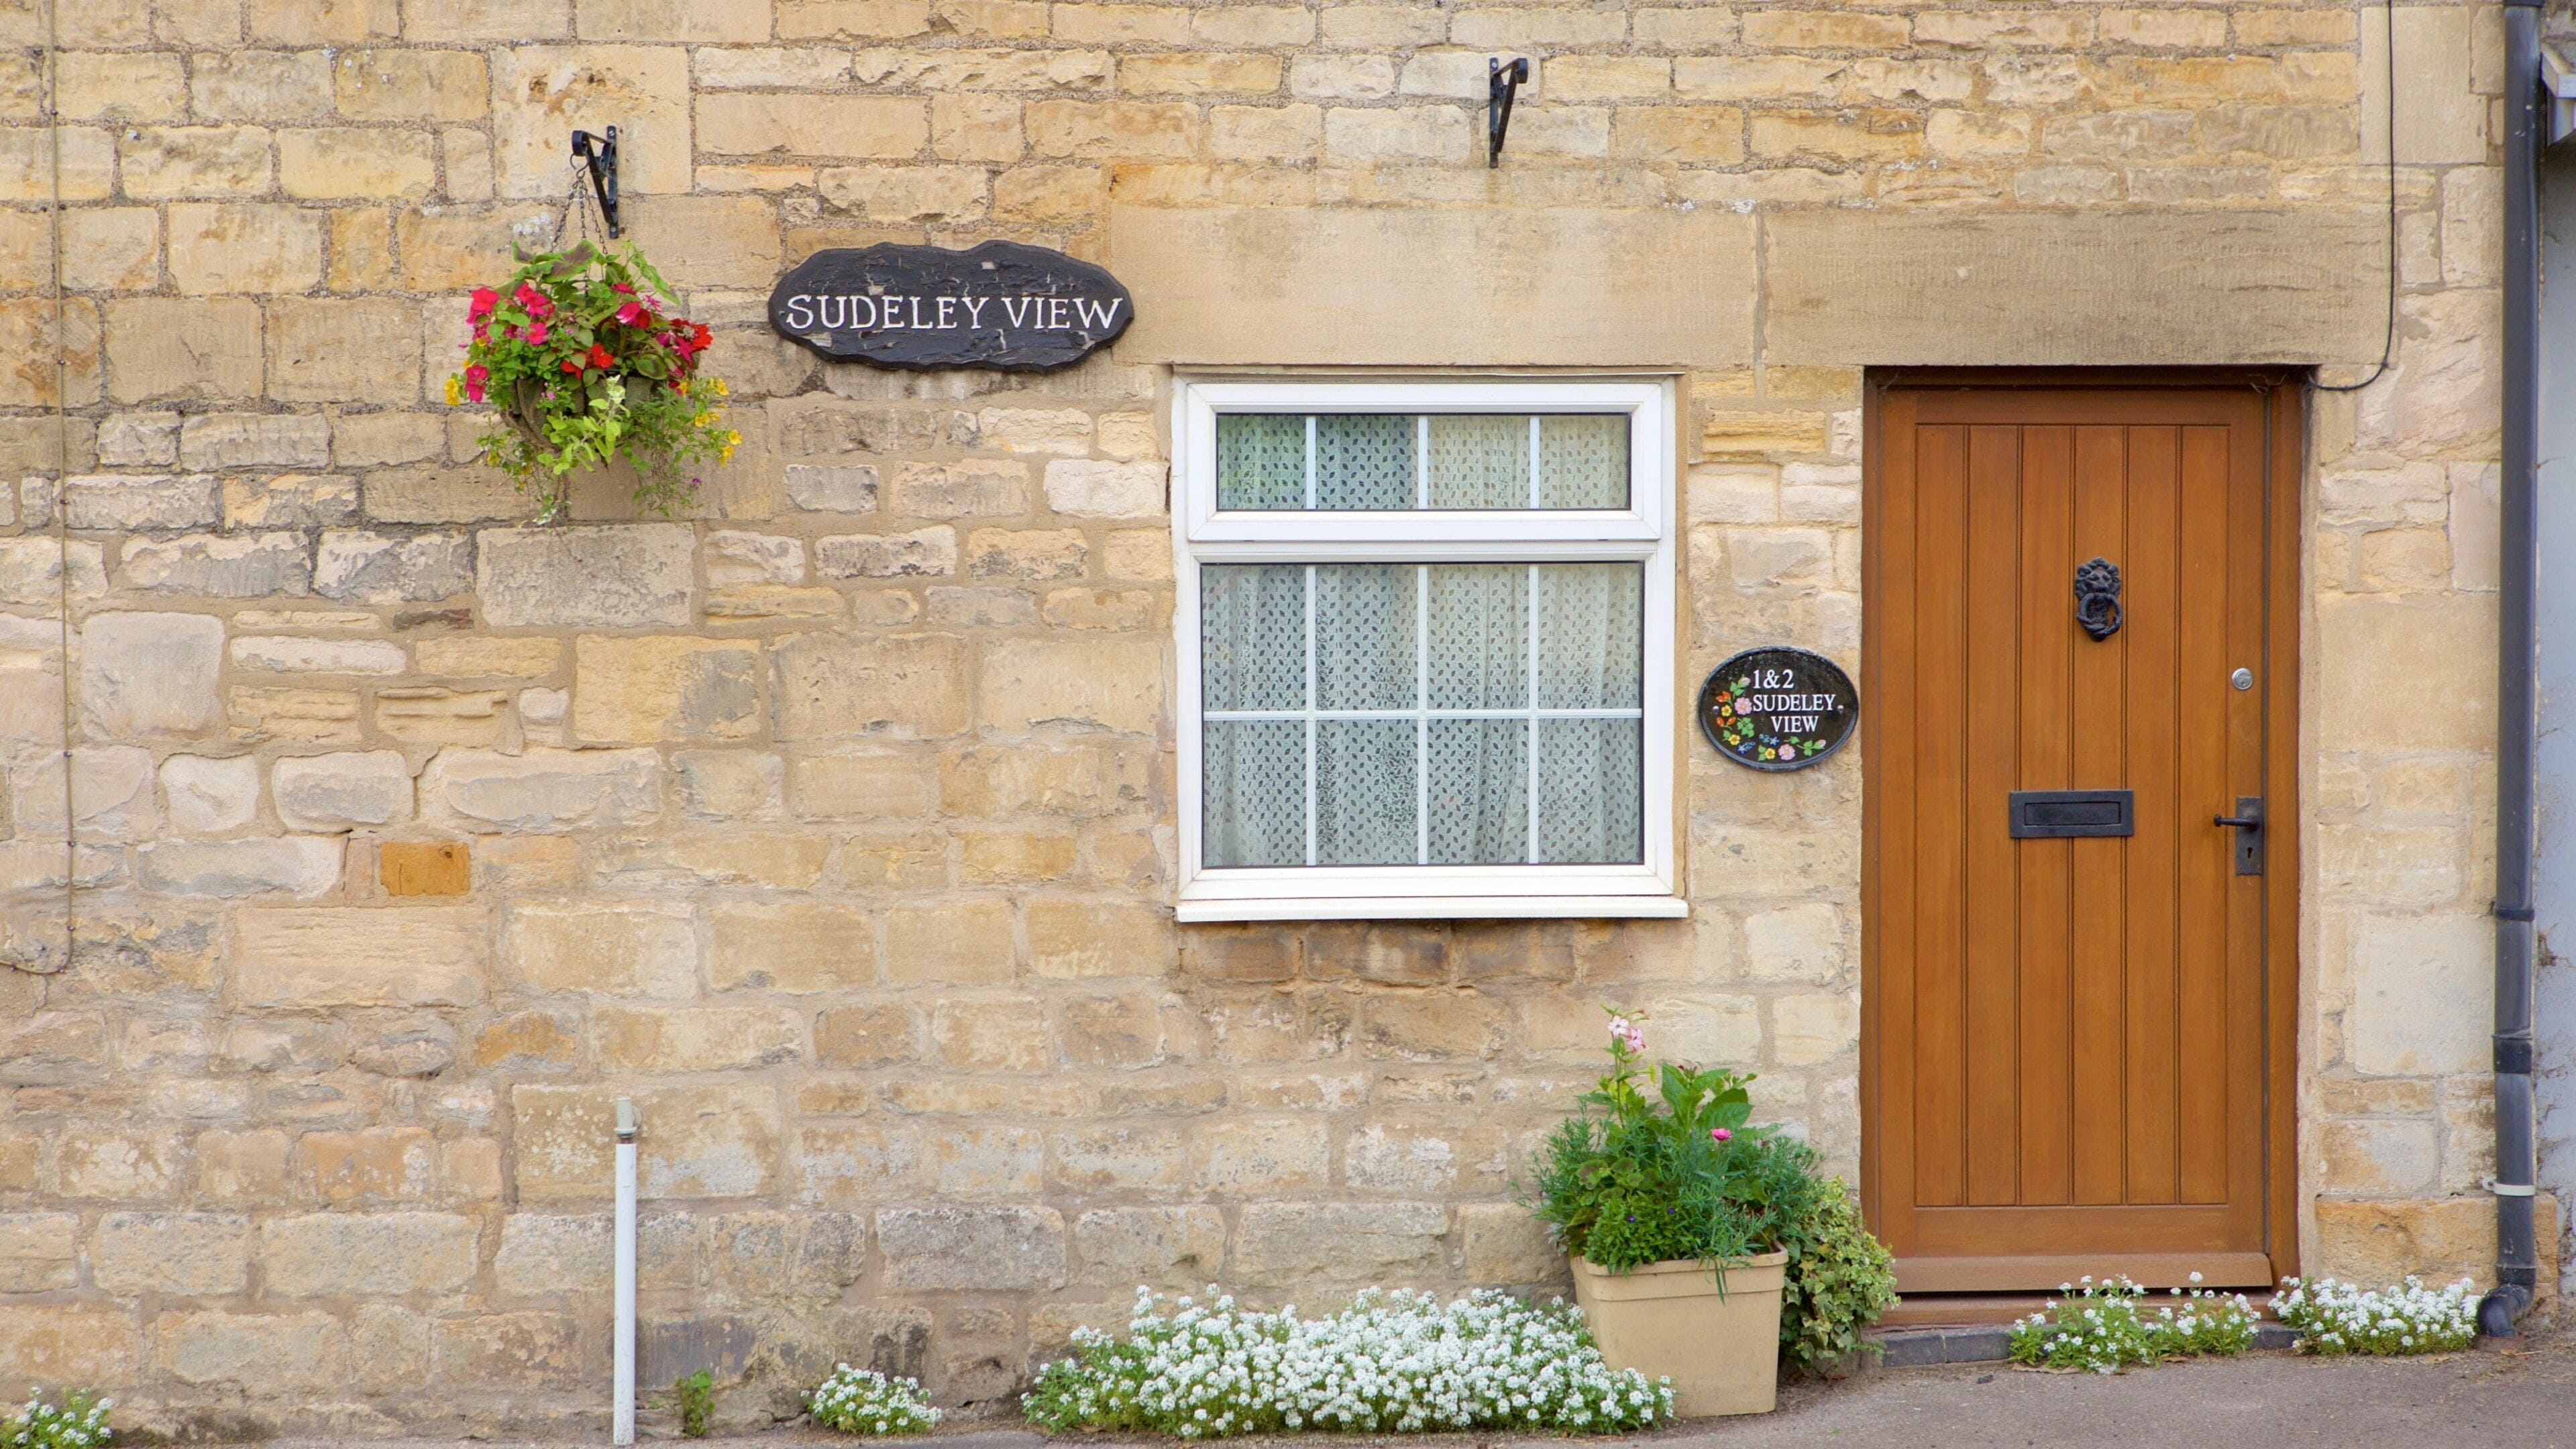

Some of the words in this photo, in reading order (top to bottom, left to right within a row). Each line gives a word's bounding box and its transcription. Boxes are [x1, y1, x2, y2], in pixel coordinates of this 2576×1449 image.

[786, 294, 989, 330] SUDELEY
[1001, 296, 1124, 329] VIEW
[1753, 669, 1794, 690] 1&2
[1753, 694, 1836, 712] SUDELEY
[1770, 715, 1819, 733] VIEW
